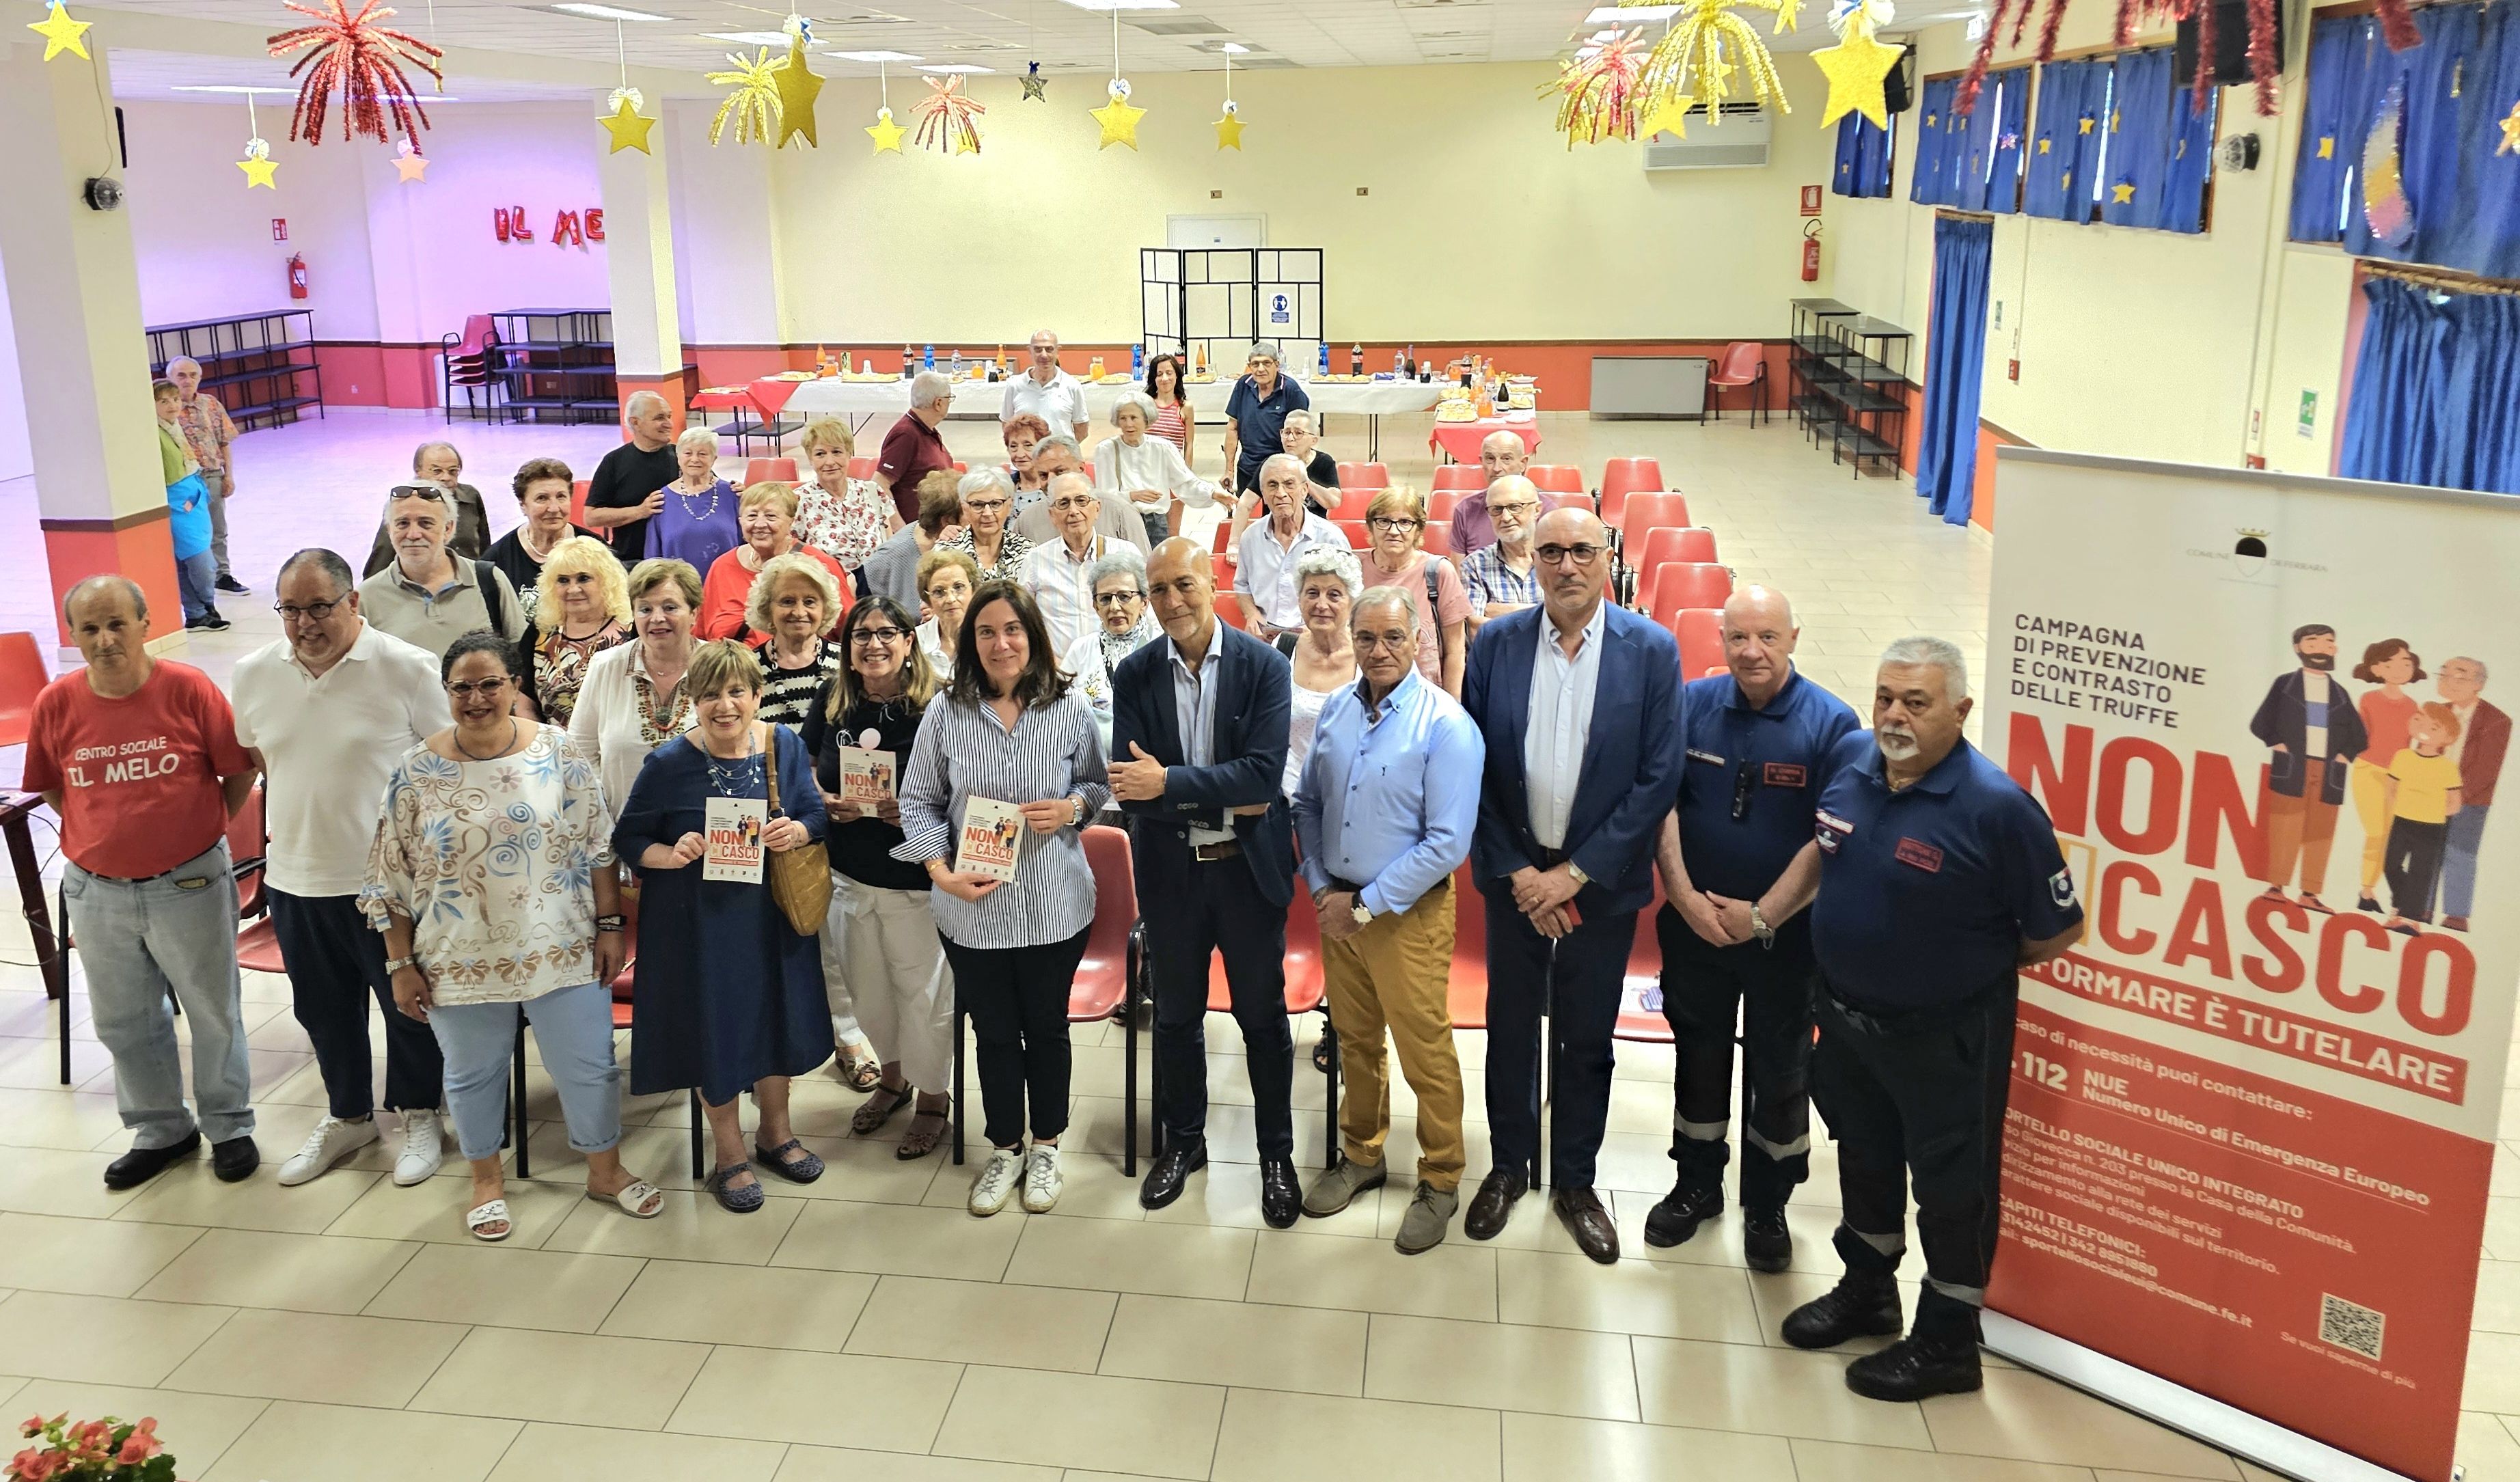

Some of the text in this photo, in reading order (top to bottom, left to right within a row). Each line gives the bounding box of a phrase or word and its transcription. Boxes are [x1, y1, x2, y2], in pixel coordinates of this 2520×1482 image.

[494, 206, 605, 245] IL ME
[2186, 548, 2230, 560] COMUNE
[2283, 560, 2329, 573] FERRARA
[2015, 614, 2145, 650] CAMPAGNA
[2012, 657, 2172, 703] E CONTRASTO
[2014, 635, 2207, 685] DI PREVENZIONE
[2011, 679, 2179, 728] DELLE TRUFFE
[75, 736, 167, 760] CENTRO SOCIALE
[68, 753, 180, 787] IL MELO
[845, 773, 875, 788] NON
[857, 787, 891, 799] CASCO
[2007, 711, 2271, 883] NON
[710, 829, 740, 845] NON
[722, 845, 759, 860] CASCO
[965, 827, 997, 845] NON
[976, 843, 1013, 860] CASCO
[2098, 860, 2477, 1037] CASCO
[2025, 958, 2454, 1093] ORMARE È TUTELARE
[2022, 1052, 2068, 1092] 112
[2051, 1030, 2065, 1046] di
[2068, 1037, 2153, 1073] necessità
[2156, 1064, 2199, 1086] puoi
[2202, 1078, 2313, 1121] contattare:
[2083, 1069, 2129, 1097] NUE
[2005, 1107, 2305, 1219] ORTELLO SOCIALE UNICO INTEGRATO
[2083, 1086, 2430, 1205] Numero Unico di Emergenza Europeo
[2003, 1139, 2146, 1196] vizio per informazioni
[2001, 1168, 2053, 1194] arattere
[2055, 1188, 2105, 1212] sociale
[2106, 1205, 2180, 1239] disponibili
[2182, 1233, 2205, 1249] sul
[2002, 1153, 2223, 1239] dirizzamento alla rete dei servizi
[2021, 1130, 2081, 1160] Giovecca
[2099, 1157, 2127, 1175] 203
[2128, 1169, 2178, 1193] presso
[2180, 1185, 2195, 1198] la
[2196, 1190, 2234, 1212] Casa
[2236, 1205, 2273, 1226] della
[2275, 1218, 2357, 1254] Comunità.
[2000, 1194, 2146, 1259] APITI TELEFONICI:
[2068, 1236, 2096, 1254] 342
[2280, 1331, 2297, 1345] Se
[2298, 1339, 2325, 1355] vuoi
